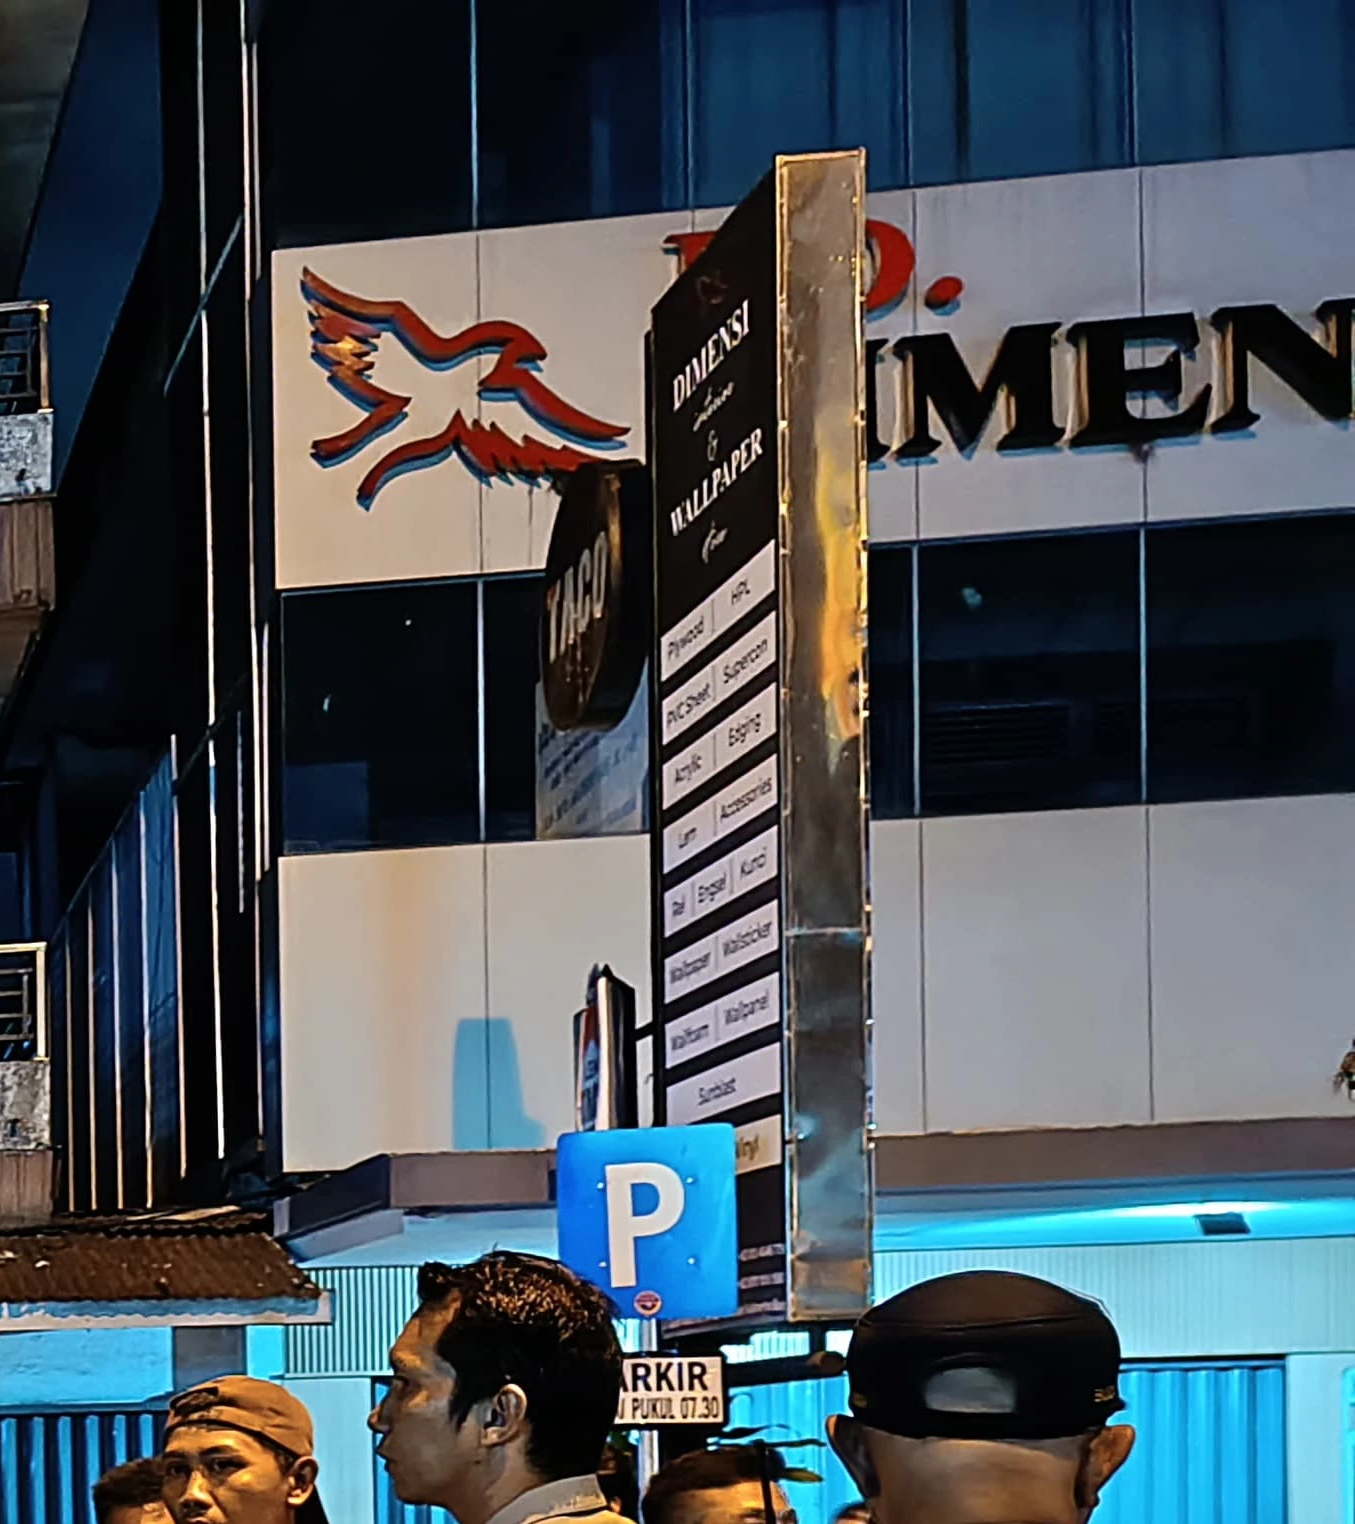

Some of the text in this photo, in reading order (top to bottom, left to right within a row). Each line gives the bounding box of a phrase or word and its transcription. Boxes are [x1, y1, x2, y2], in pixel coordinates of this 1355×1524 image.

[672, 298, 750, 412] DIMENSI
[670, 427, 763, 537] WALLPAPER
[547, 531, 608, 664] TACO
[731, 577, 752, 605] HPL
[667, 616, 705, 660] Plywood
[723, 638, 768, 684] Supercon
[728, 712, 762, 748] Edging
[720, 776, 773, 820] Accessories
[604, 1161, 685, 1288] P
[631, 1397, 675, 1420] PUKUL
[680, 1396, 719, 1420] 07.30
